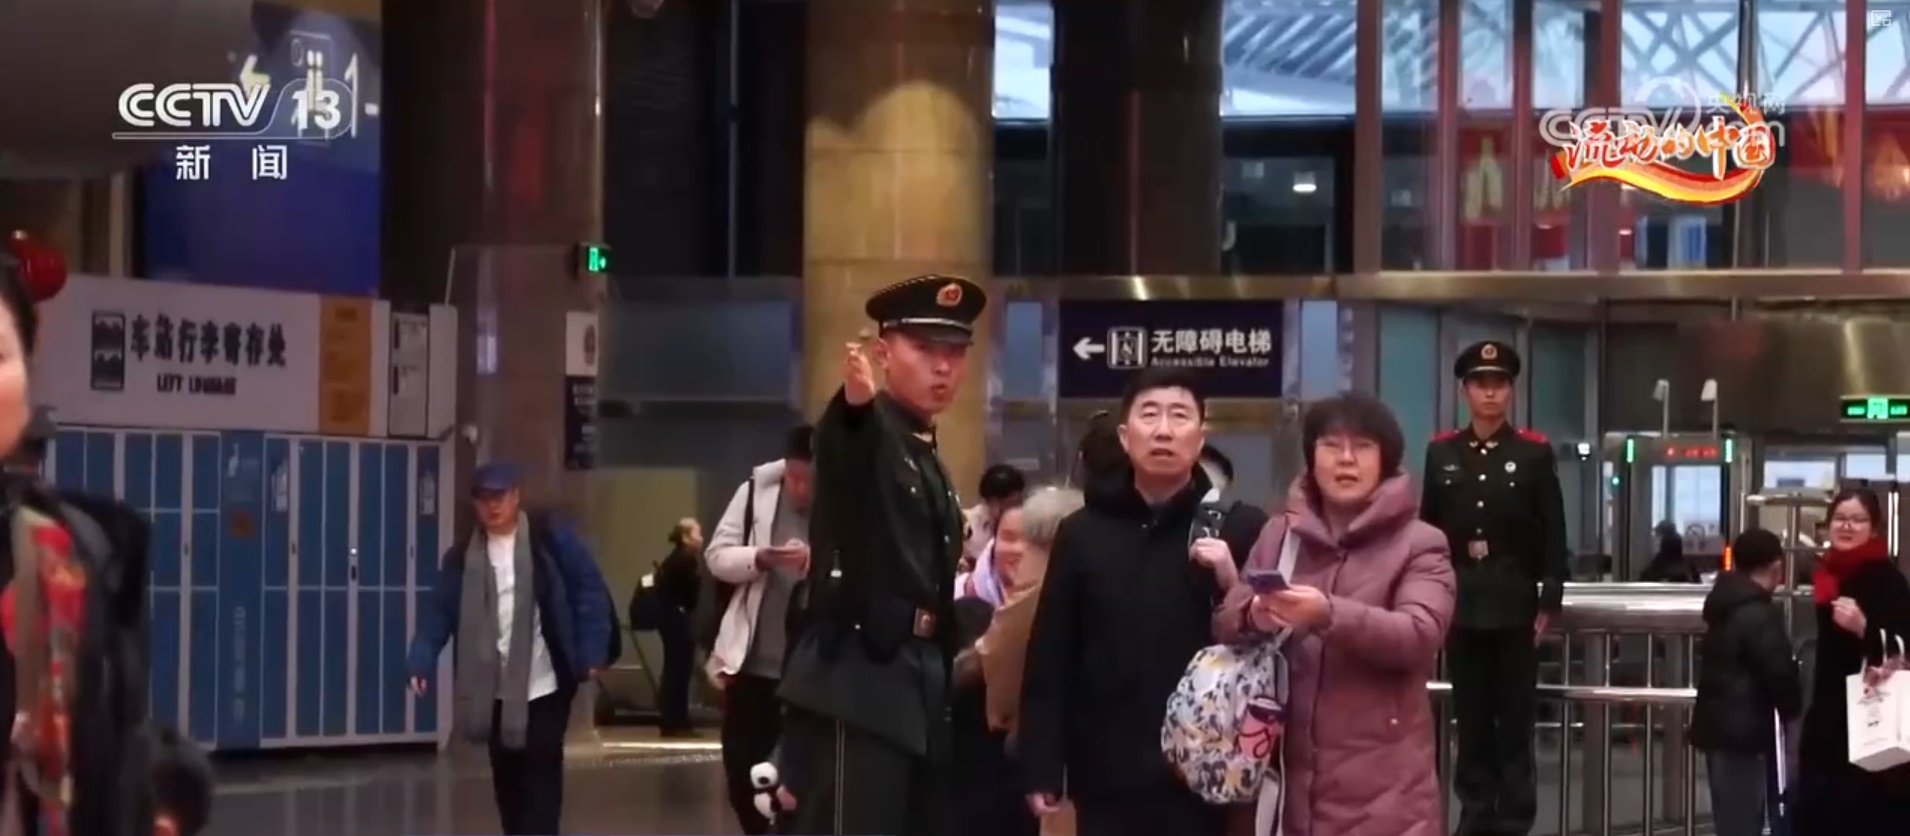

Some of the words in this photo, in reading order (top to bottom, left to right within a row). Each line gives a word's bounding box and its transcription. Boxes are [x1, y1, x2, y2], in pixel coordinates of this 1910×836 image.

[130, 314, 287, 367] 车站行李寄存处
[1151, 329, 1272, 354] 无障碍电梯
[1151, 356, 1215, 367] Accessible
[1219, 356, 1270, 367] Elevator
